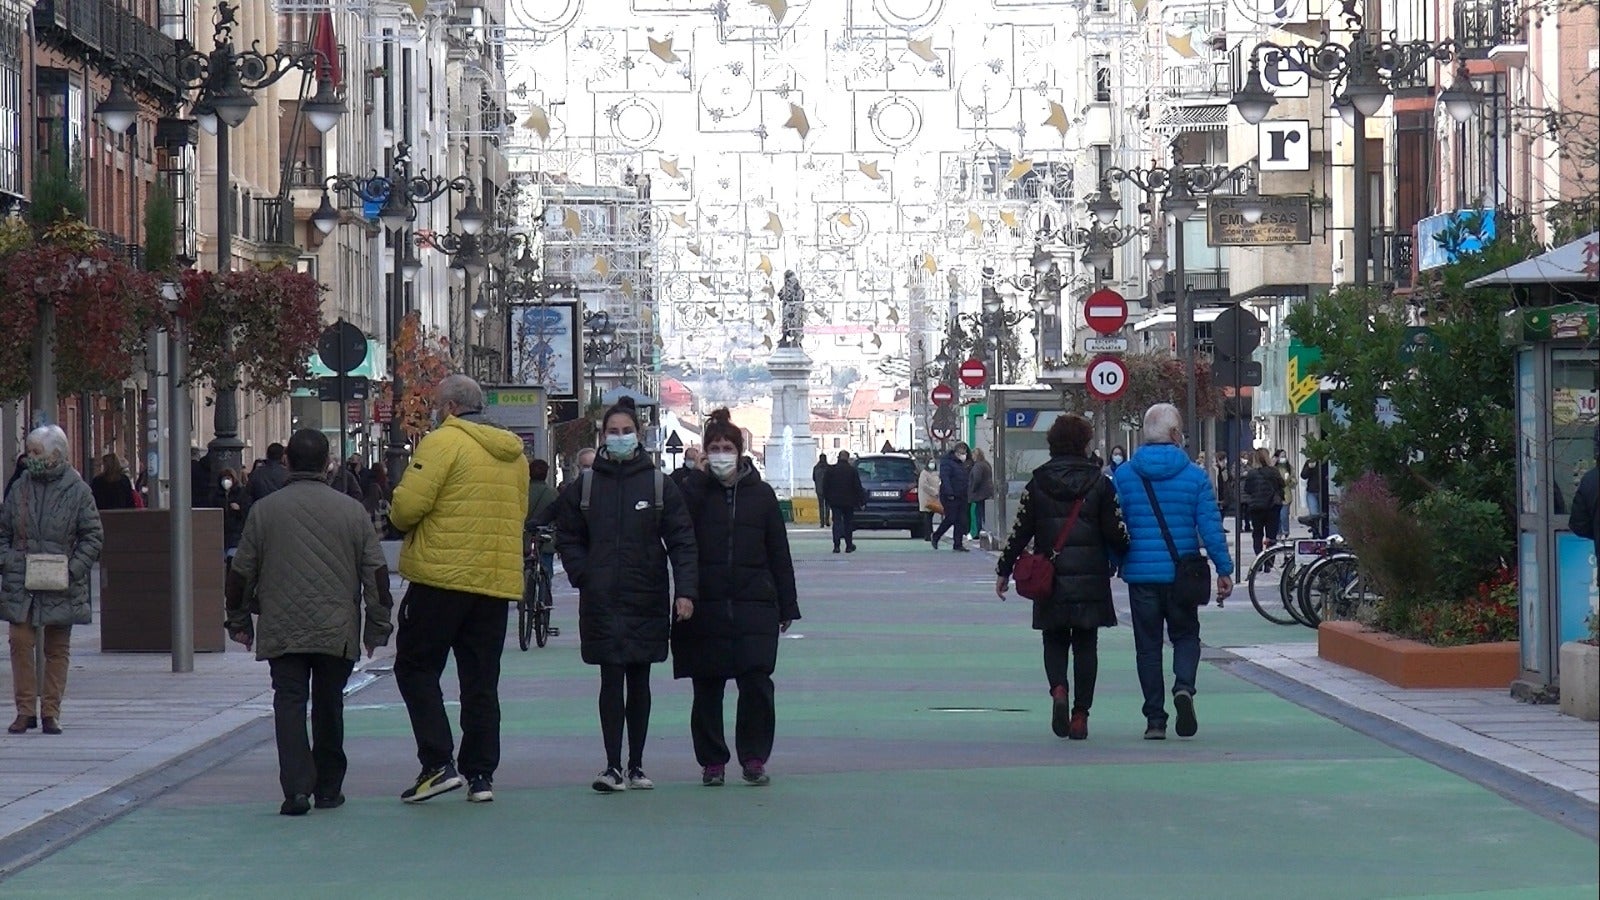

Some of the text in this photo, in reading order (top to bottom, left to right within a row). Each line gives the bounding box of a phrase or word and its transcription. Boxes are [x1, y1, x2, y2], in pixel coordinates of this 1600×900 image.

[1266, 129, 1301, 162] r
[1211, 198, 1283, 209] ASEIA
[1220, 213, 1298, 225] EMESAS
[1098, 371, 1117, 385] 10
[502, 394, 534, 403] ONCE
[1580, 396, 1596, 410] 10
[1015, 412, 1026, 427] P
